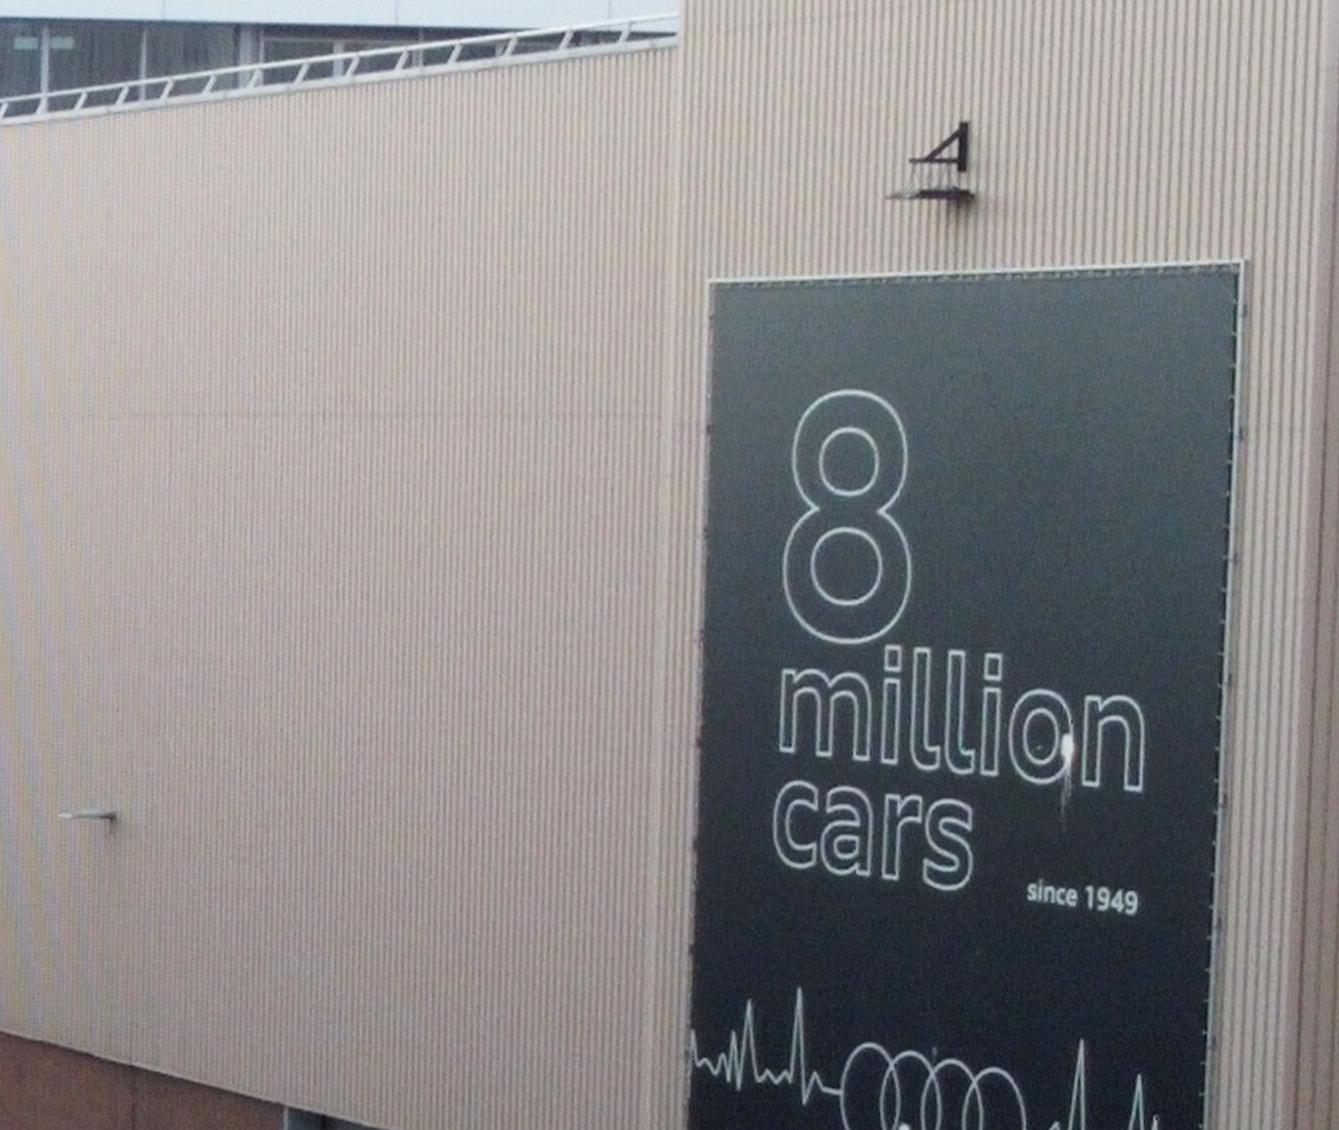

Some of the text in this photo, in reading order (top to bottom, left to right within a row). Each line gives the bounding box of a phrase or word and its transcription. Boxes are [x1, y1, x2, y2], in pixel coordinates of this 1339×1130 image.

[782, 388, 912, 645] 8
[778, 644, 1146, 793] million
[772, 779, 974, 892] cars
[1026, 879, 1139, 916] since 1949
